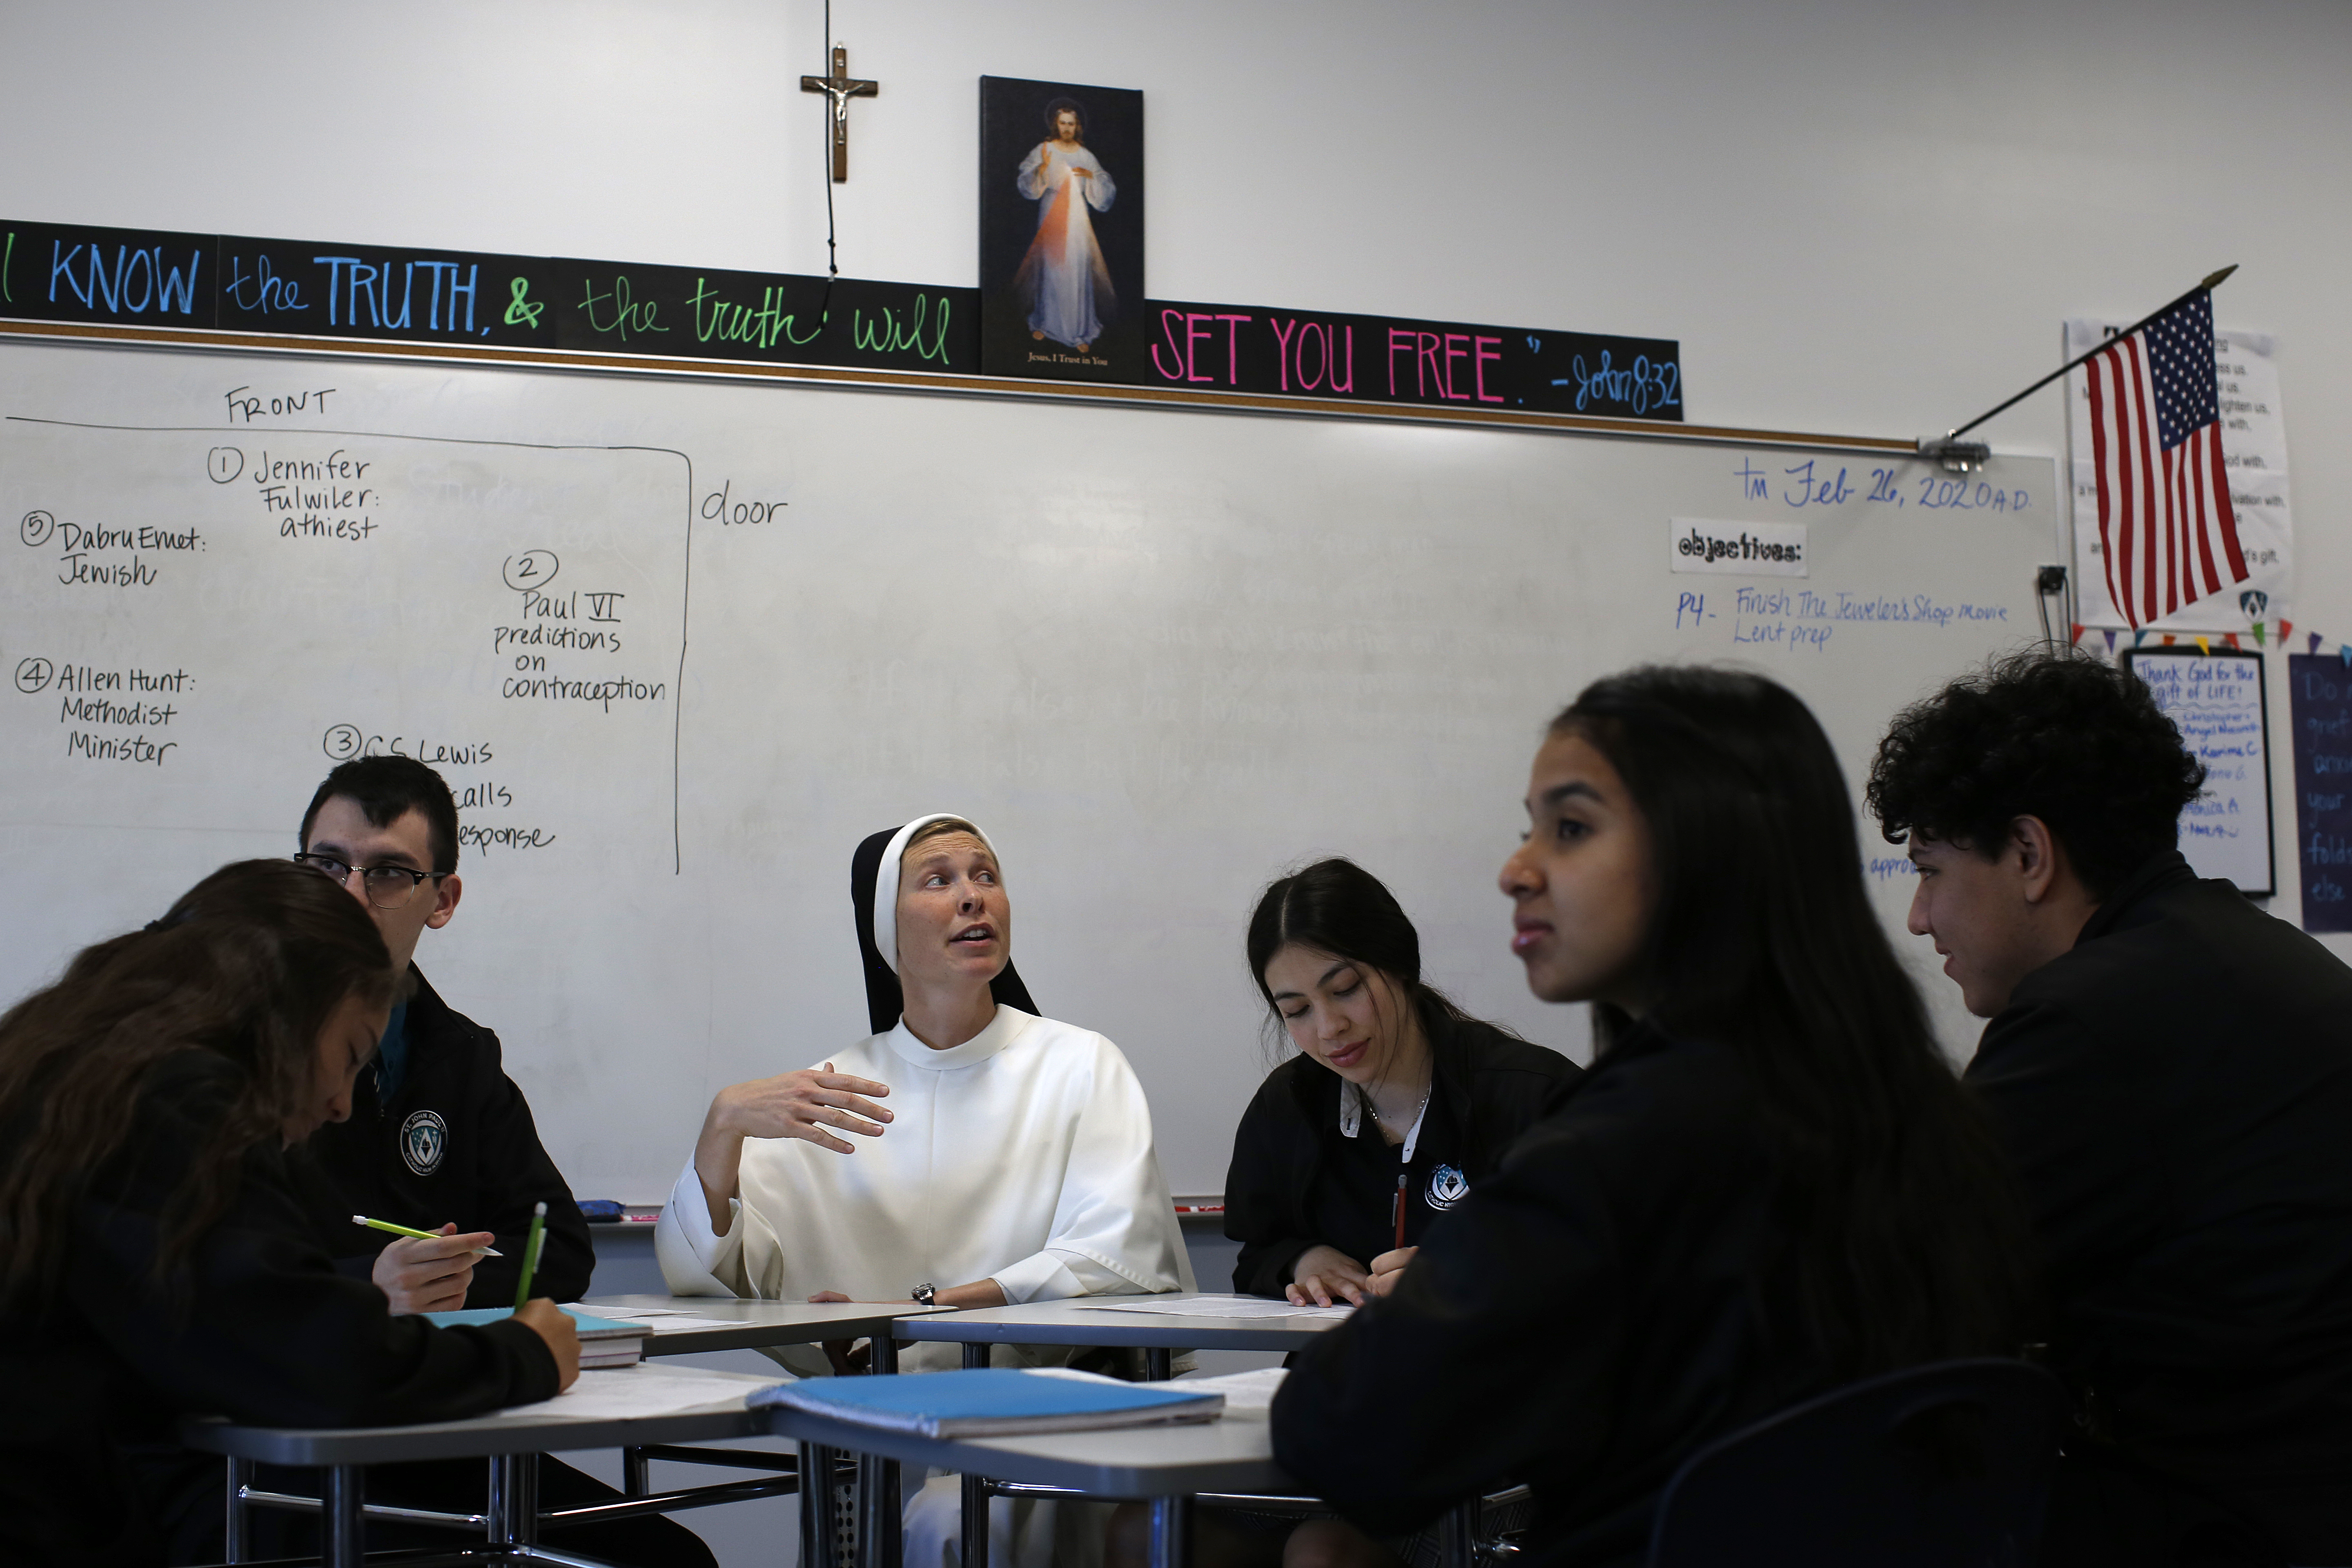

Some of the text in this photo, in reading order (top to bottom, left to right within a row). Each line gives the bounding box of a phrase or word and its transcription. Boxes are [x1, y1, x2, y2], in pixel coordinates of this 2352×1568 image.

[49, 239, 200, 314] KNOW
[226, 254, 310, 314] the
[314, 256, 490, 336] TRUTH,
[504, 276, 544, 329] &
[578, 276, 670, 342] the
[854, 293, 950, 365] will
[1151, 309, 1252, 385] SET
[1270, 318, 1353, 393] YOU
[1052, 353, 1057, 363] I
[1058, 354, 1080, 364] Trust
[1082, 356, 1091, 365] in
[1091, 356, 1108, 366] You
[224, 385, 336, 423] FRONT
[254, 449, 370, 484] Jennifer
[701, 479, 788, 526] door
[57, 522, 134, 552] Dabru
[280, 512, 379, 541] athiest
[1678, 527, 1802, 563] objectives:
[58, 552, 157, 587] Jewish
[522, 590, 577, 619] Paul
[1737, 586, 1791, 617] Finish
[494, 624, 621, 655] predictions
[1734, 617, 1833, 653] Lent prep
[58, 664, 120, 692] Allen
[129, 668, 196, 693] Hunt:
[515, 655, 545, 672] on
[60, 695, 178, 725] Methodist
[502, 675, 666, 714] contraception
[68, 730, 177, 766] Minister
[419, 739, 493, 764] Lewis
[412, 1112, 428, 1123] JOHN
